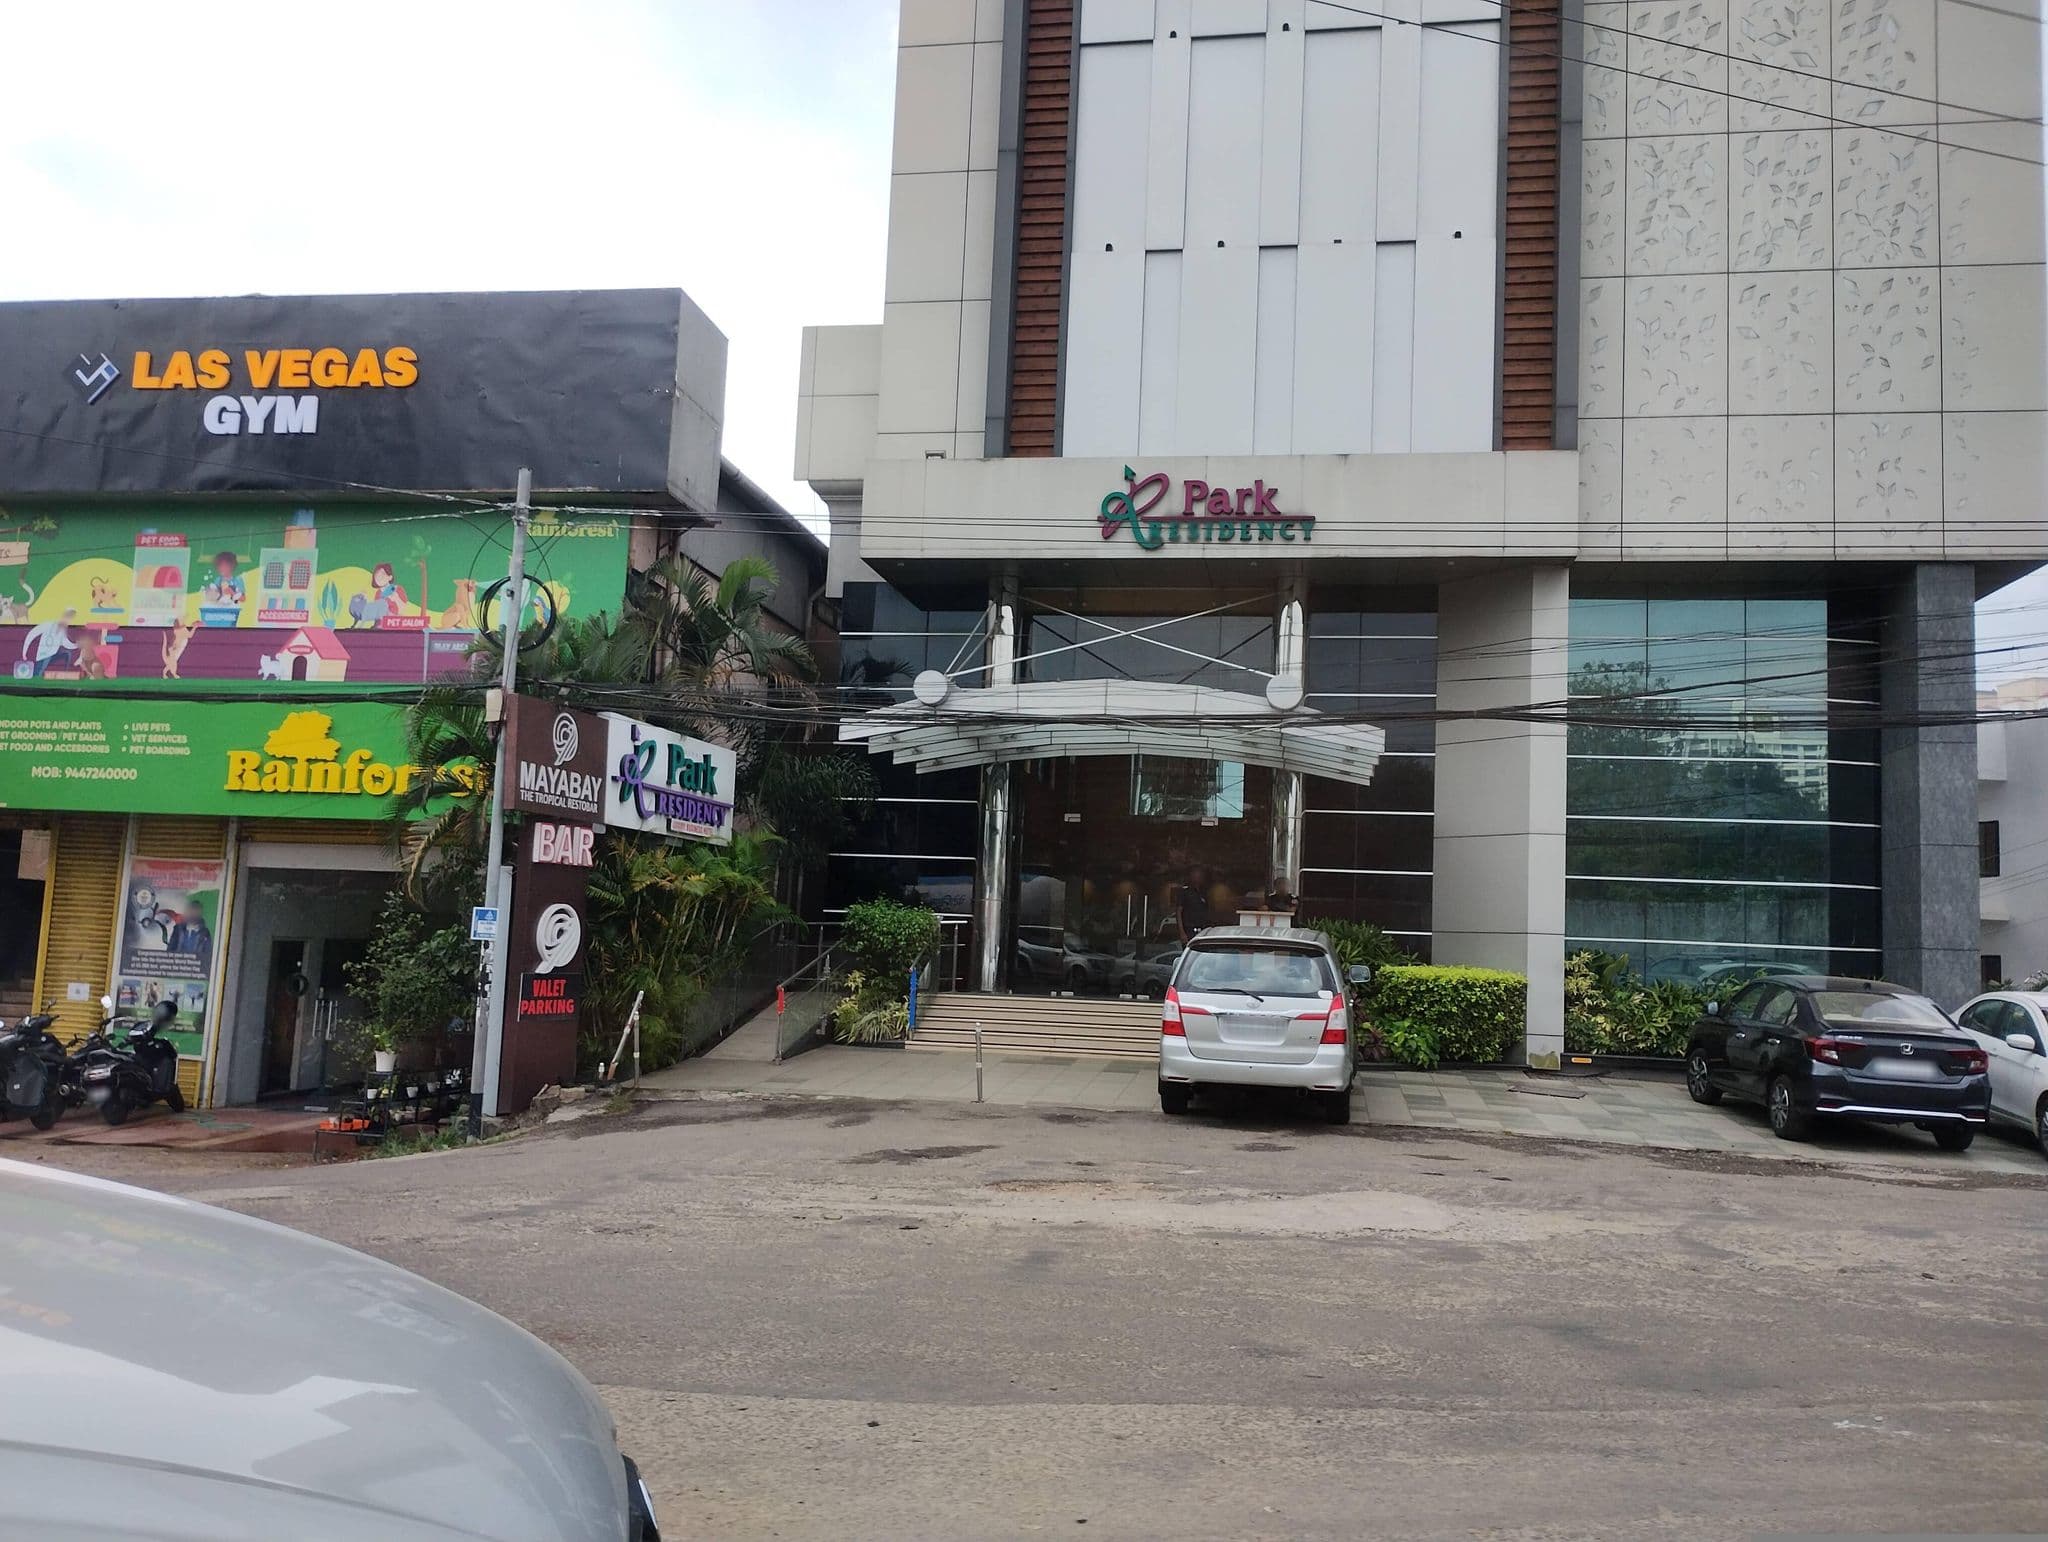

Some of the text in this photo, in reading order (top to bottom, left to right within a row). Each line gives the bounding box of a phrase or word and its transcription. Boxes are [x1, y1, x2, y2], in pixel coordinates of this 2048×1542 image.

[132, 346, 419, 389] LAS VEGAS
[203, 395, 319, 435] GYM
[1182, 479, 1281, 516] Park
[141, 536, 157, 545] PET
[1149, 521, 1315, 542] RESIDENCY
[387, 618, 401, 627] PET
[0, 720, 102, 731] NDOOR POTS AND PLANTS
[132, 722, 171, 732] LIVE PETS
[0, 731, 9, 739] ET
[10, 731, 57, 741] GROOMING
[62, 732, 77, 741] PET
[78, 733, 106, 742] SALON
[131, 734, 188, 744] VET SERVICES
[0, 742, 110, 754] ET FOOD AND ACCESSORIES
[129, 745, 191, 756] PET BOARDING
[32, 766, 137, 780] MOB: 9447240000
[223, 748, 490, 799] Rainfors
[665, 743, 718, 795] Park
[519, 760, 602, 802] MAYABAY
[520, 789, 598, 814] THE TROPICAL RESTOBAR
[655, 792, 728, 828] RESIDENCY
[532, 822, 595, 868] BAR
[532, 979, 567, 997] VALET
[520, 999, 575, 1015] PARKING
